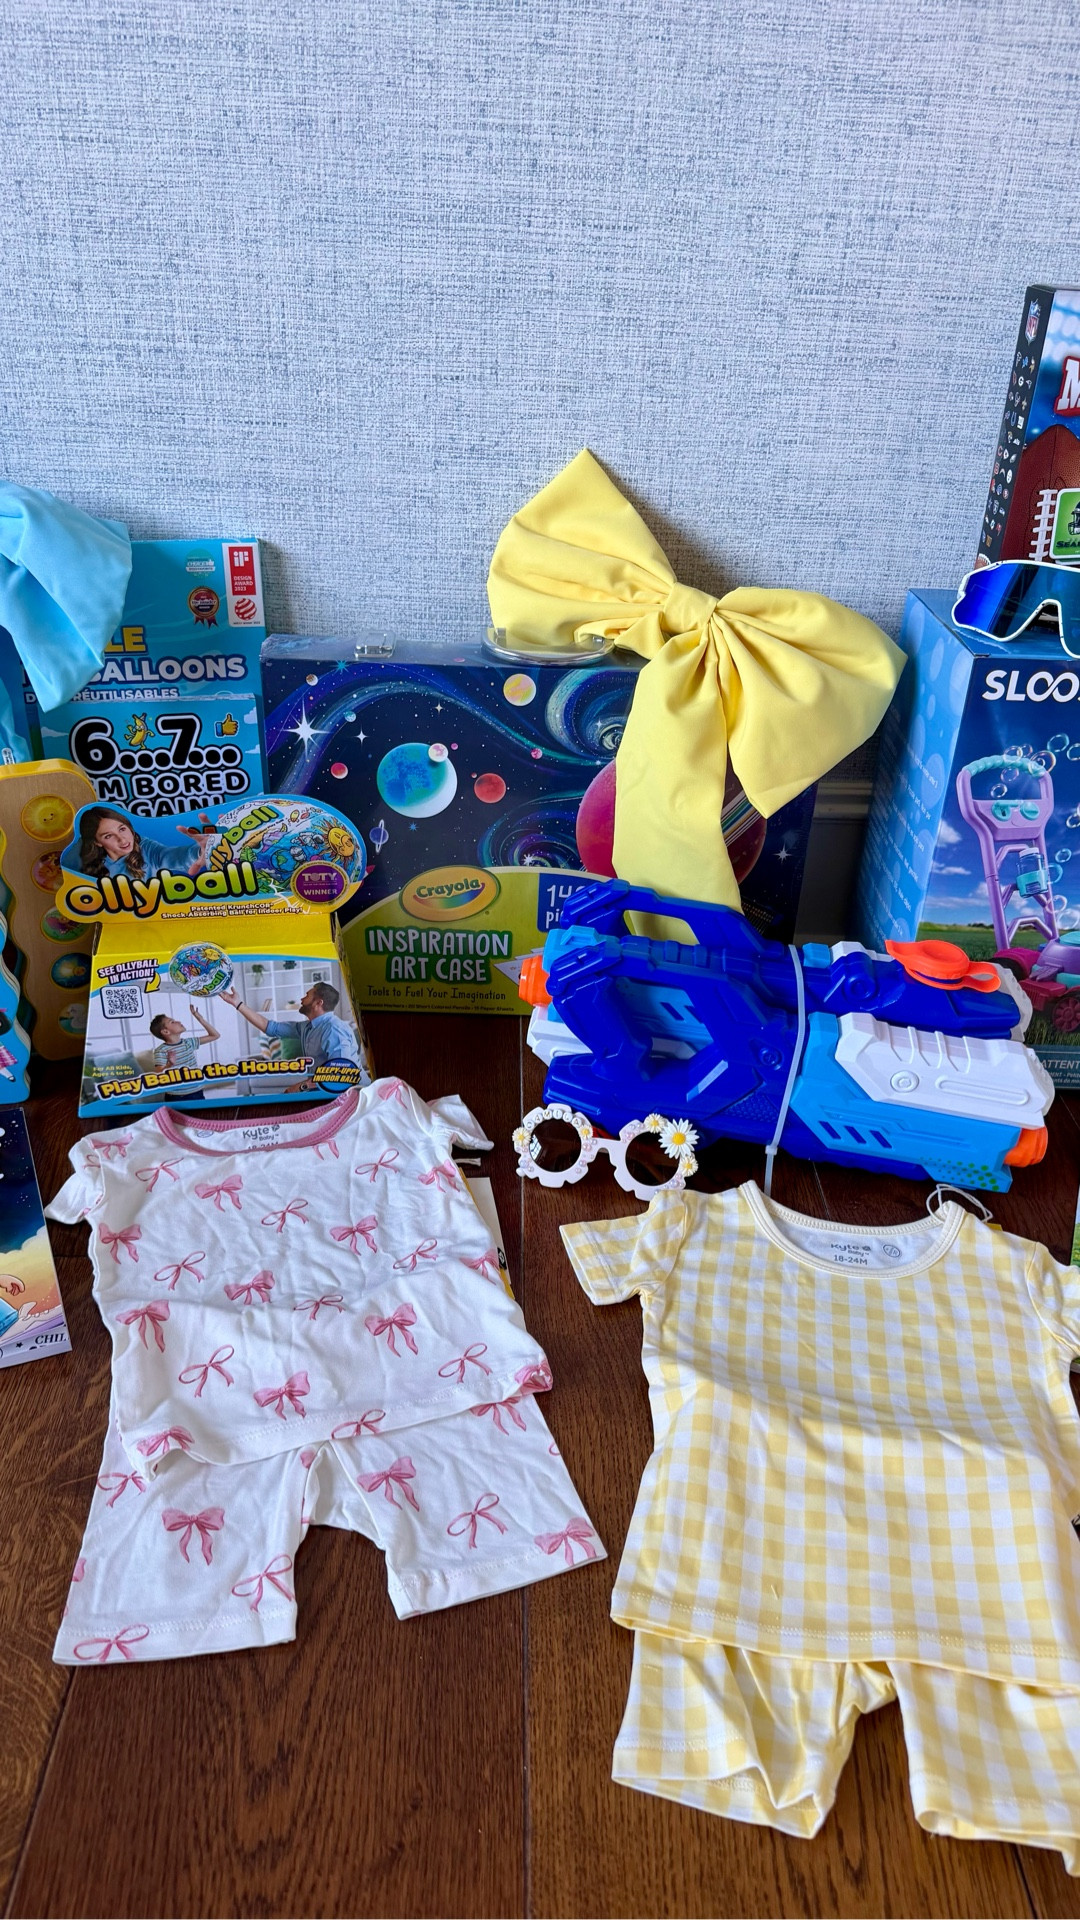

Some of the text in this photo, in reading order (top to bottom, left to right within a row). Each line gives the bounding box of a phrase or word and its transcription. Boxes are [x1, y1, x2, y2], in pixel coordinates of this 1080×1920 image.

[982, 670, 1080, 703] SLOO
[134, 771, 247, 797] BORED
[68, 862, 258, 915] ollyball
[415, 878, 481, 899] Crayola
[547, 884, 585, 907] 14
[546, 909, 563, 929] pi
[368, 929, 509, 956] INSPIRATION
[99, 959, 159, 977] SEE OLLYBALL
[110, 968, 155, 984] IN ACTION!
[390, 957, 487, 982] ART CASE
[367, 985, 506, 1003] Tools to Fuel Your Imagination
[101, 1059, 305, 1096] Play Ball in the House!
[316, 1066, 360, 1075] KEEPY-UPPY
[340, 1075, 360, 1083] BALL!
[525, 1110, 581, 1129] CAMILA
[242, 1126, 270, 1140] Kyte
[831, 1243, 860, 1252] Kyte
[834, 1254, 868, 1265] 18-24M
[35, 1333, 69, 1345] CHIL
